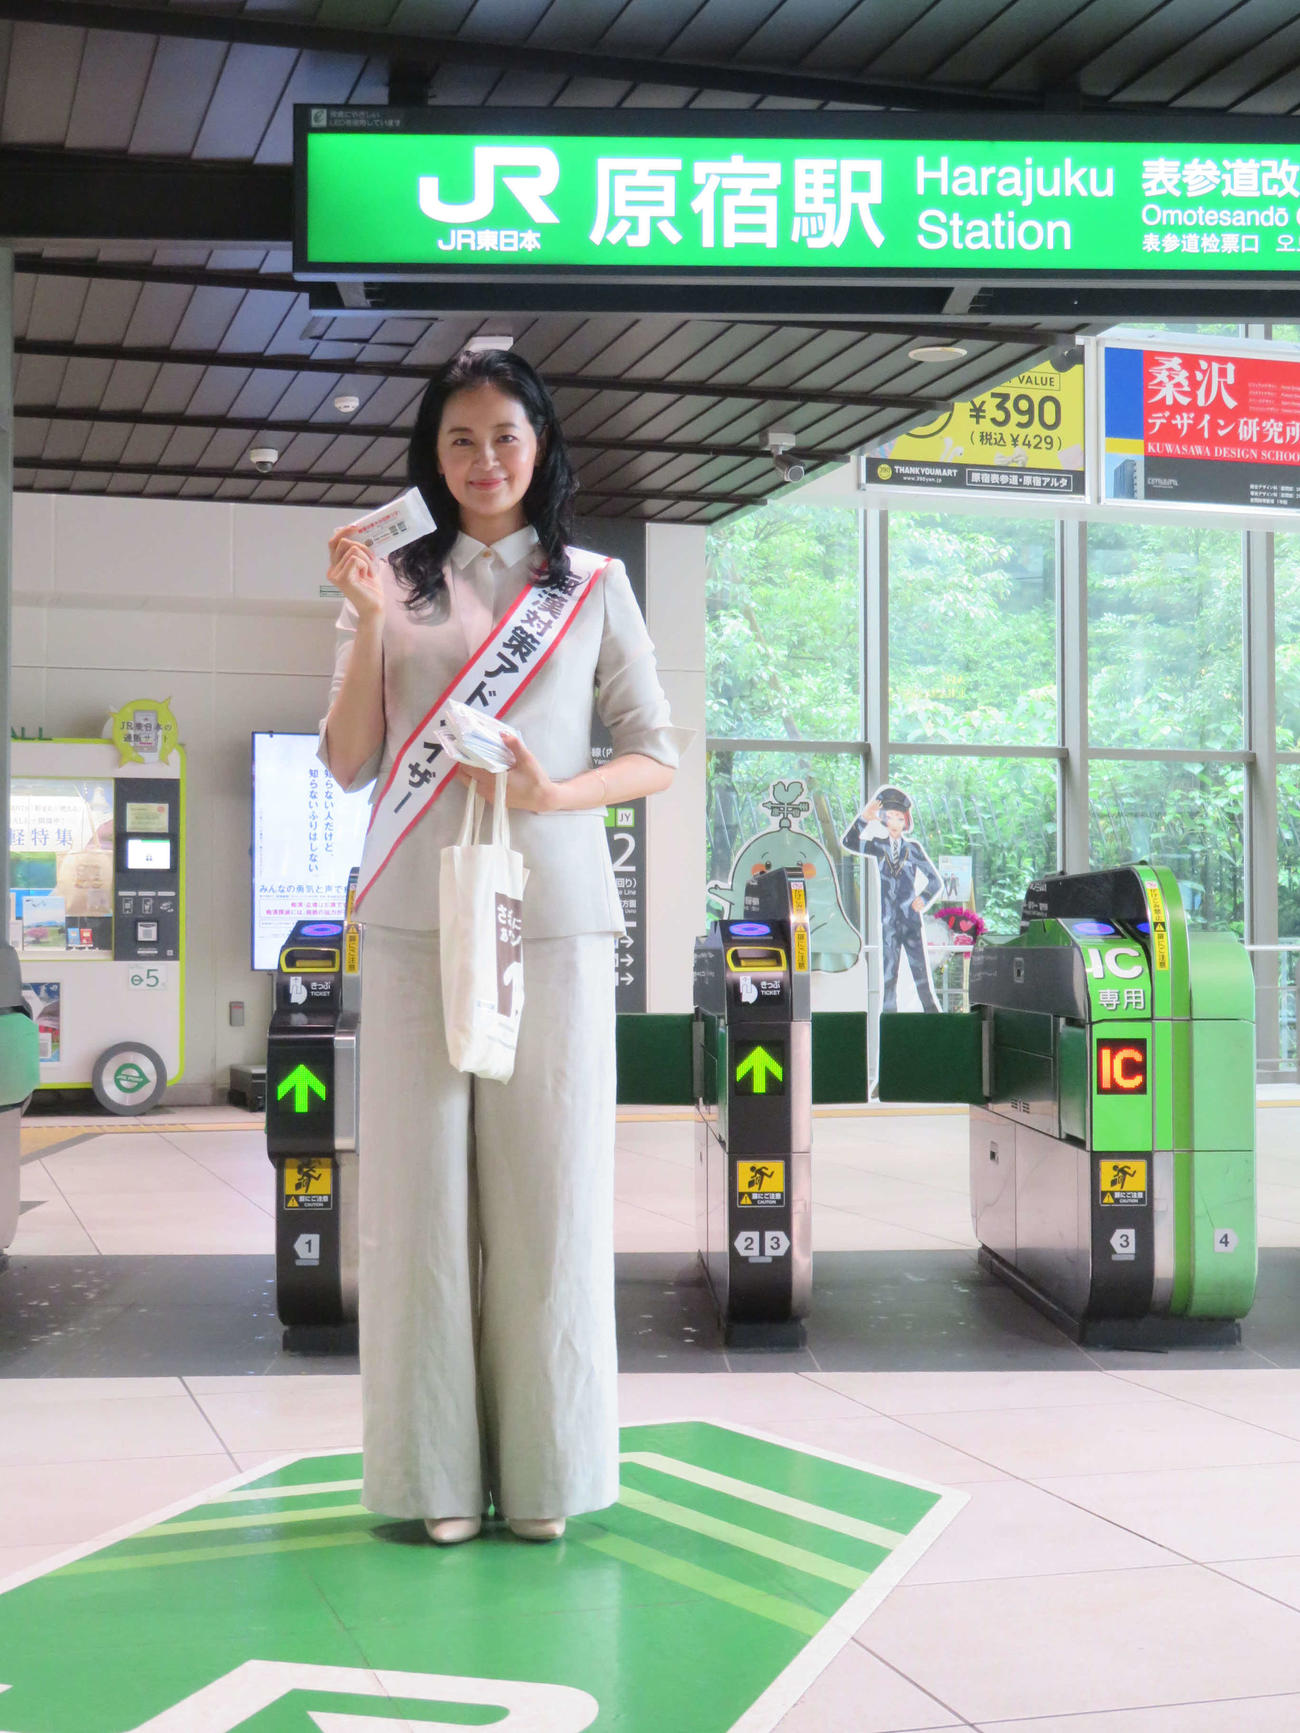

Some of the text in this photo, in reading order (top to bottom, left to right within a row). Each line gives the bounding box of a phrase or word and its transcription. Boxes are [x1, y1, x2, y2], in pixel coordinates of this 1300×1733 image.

[418, 146, 560, 223] JR
[915, 156, 1114, 206] Harajuku
[1142, 158, 1300, 199] 表参道改
[589, 155, 885, 249] 原宿駅
[1142, 204, 1289, 228] Omotesandō
[438, 229, 541, 252] JR東日本
[916, 209, 1072, 251] Station
[1142, 232, 1260, 254] 表参道检票口
[1275, 233, 1300, 252] 오
[1017, 374, 1056, 388] VALUE
[1147, 355, 1238, 410] 桑沢
[968, 391, 1062, 431] ¥390
[1147, 411, 1300, 445] デザイン研究所
[1147, 441, 1211, 458] KUWASAWA
[1214, 446, 1258, 460] DESIGN
[394, 573, 583, 814] 痴漢対策アドイザー
[619, 812, 632, 824] JY
[612, 832, 637, 873] 2
[259, 885, 347, 894] みんなの勇気と声で
[1086, 947, 1143, 979] IC
[145, 968, 160, 988] 5
[760, 980, 781, 990] きっぷ
[310, 990, 331, 998] TICKET
[760, 989, 781, 997] TICKET
[1098, 988, 1146, 1011] 専用
[1101, 1047, 1144, 1090] IC
[304, 1239, 313, 1254] 1
[743, 1236, 781, 1251] 2 3
[1119, 1233, 1130, 1249] 3
[1218, 1232, 1230, 1248] 4
